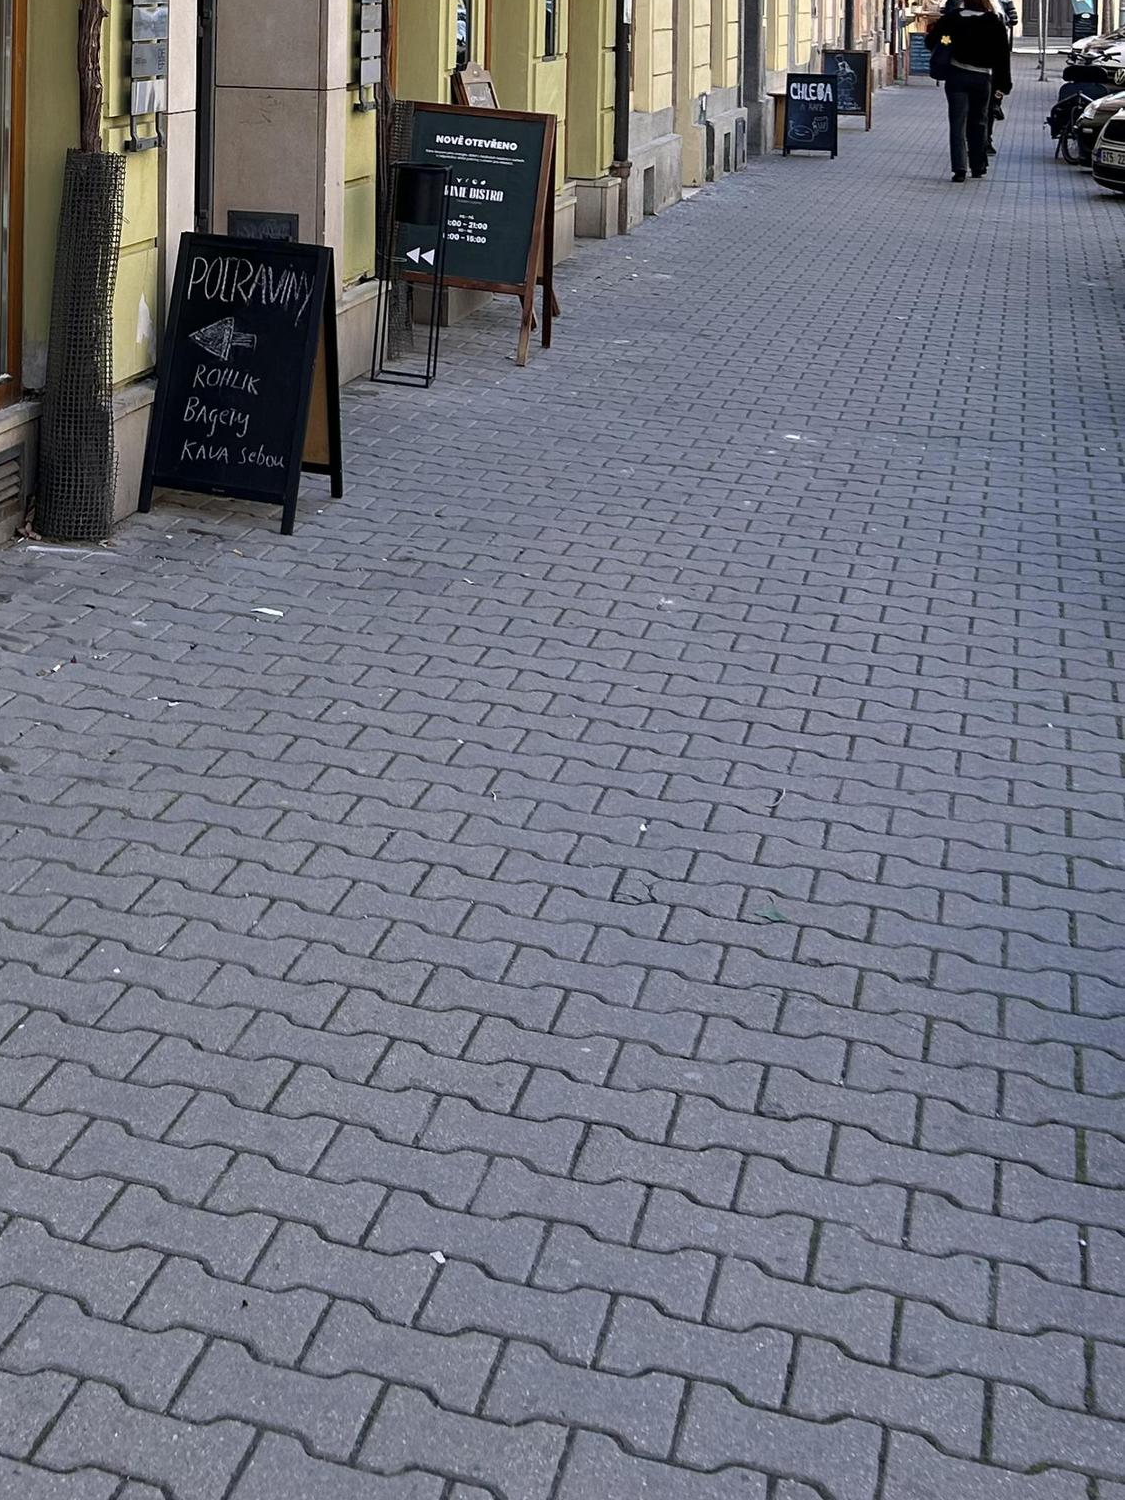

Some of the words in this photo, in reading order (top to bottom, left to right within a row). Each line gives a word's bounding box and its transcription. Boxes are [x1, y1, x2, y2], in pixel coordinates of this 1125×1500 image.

[790, 83, 833, 102] CHLEBA
[465, 138, 518, 151] OTEVŘENO
[469, 187, 504, 202] BISTRO
